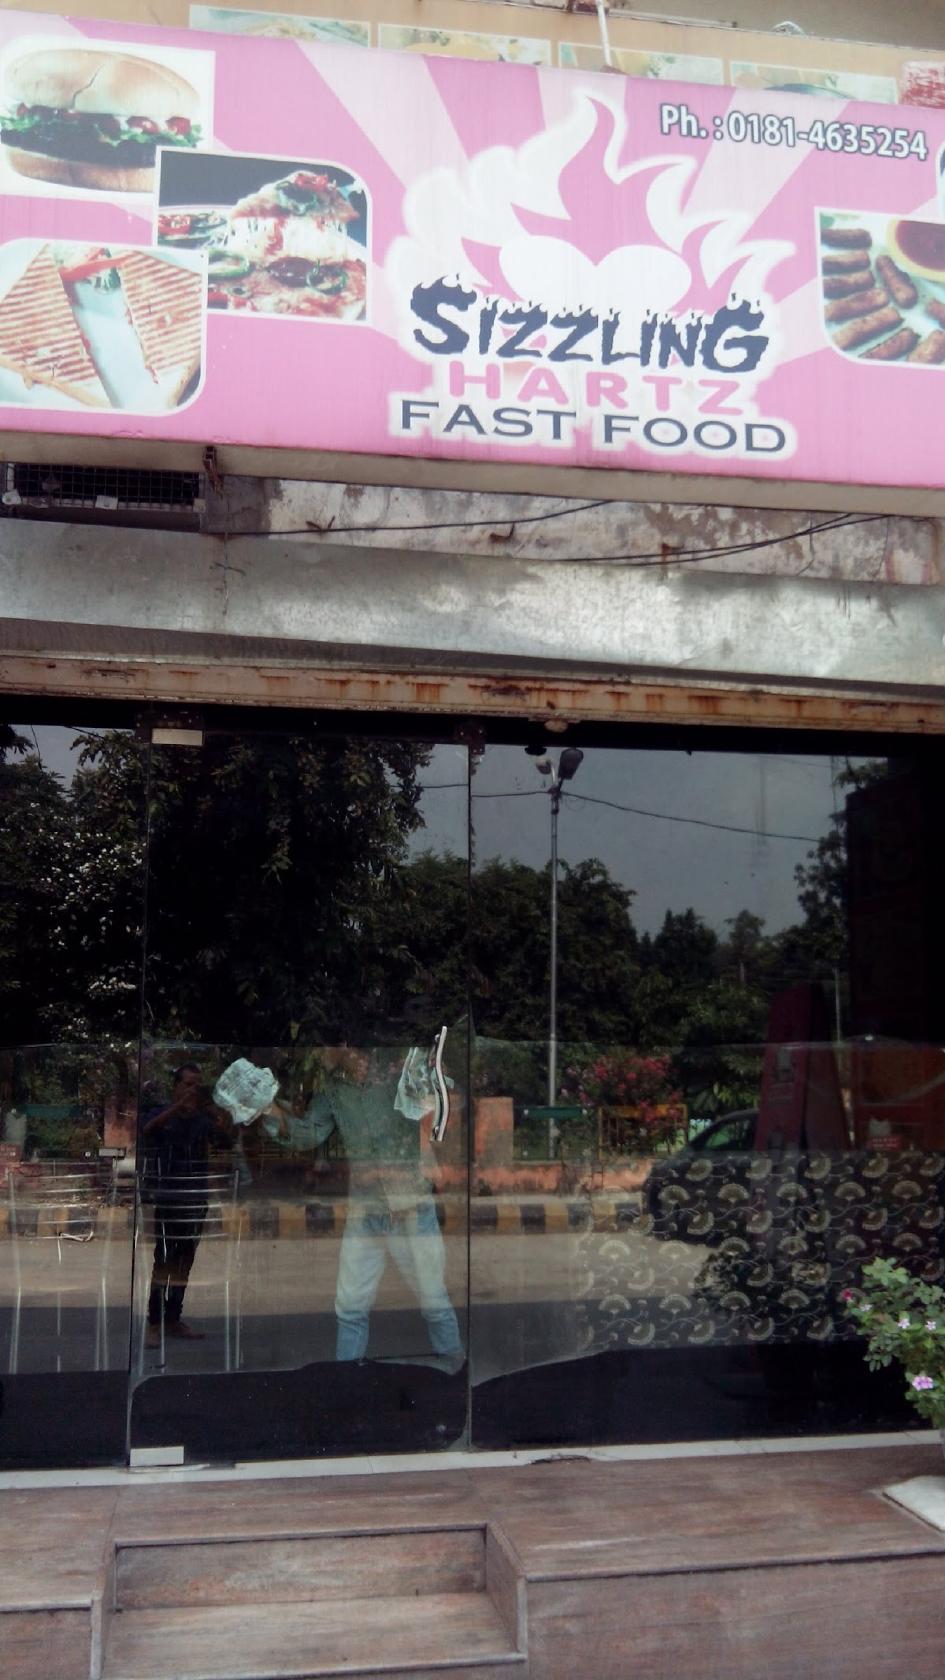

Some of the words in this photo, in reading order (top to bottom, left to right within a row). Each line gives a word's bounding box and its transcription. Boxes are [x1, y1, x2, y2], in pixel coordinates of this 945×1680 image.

[410, 274, 769, 373] SIZZLING
[449, 361, 744, 416] HARTZ
[401, 400, 577, 440] FAST
[603, 414, 786, 453] FOOD
